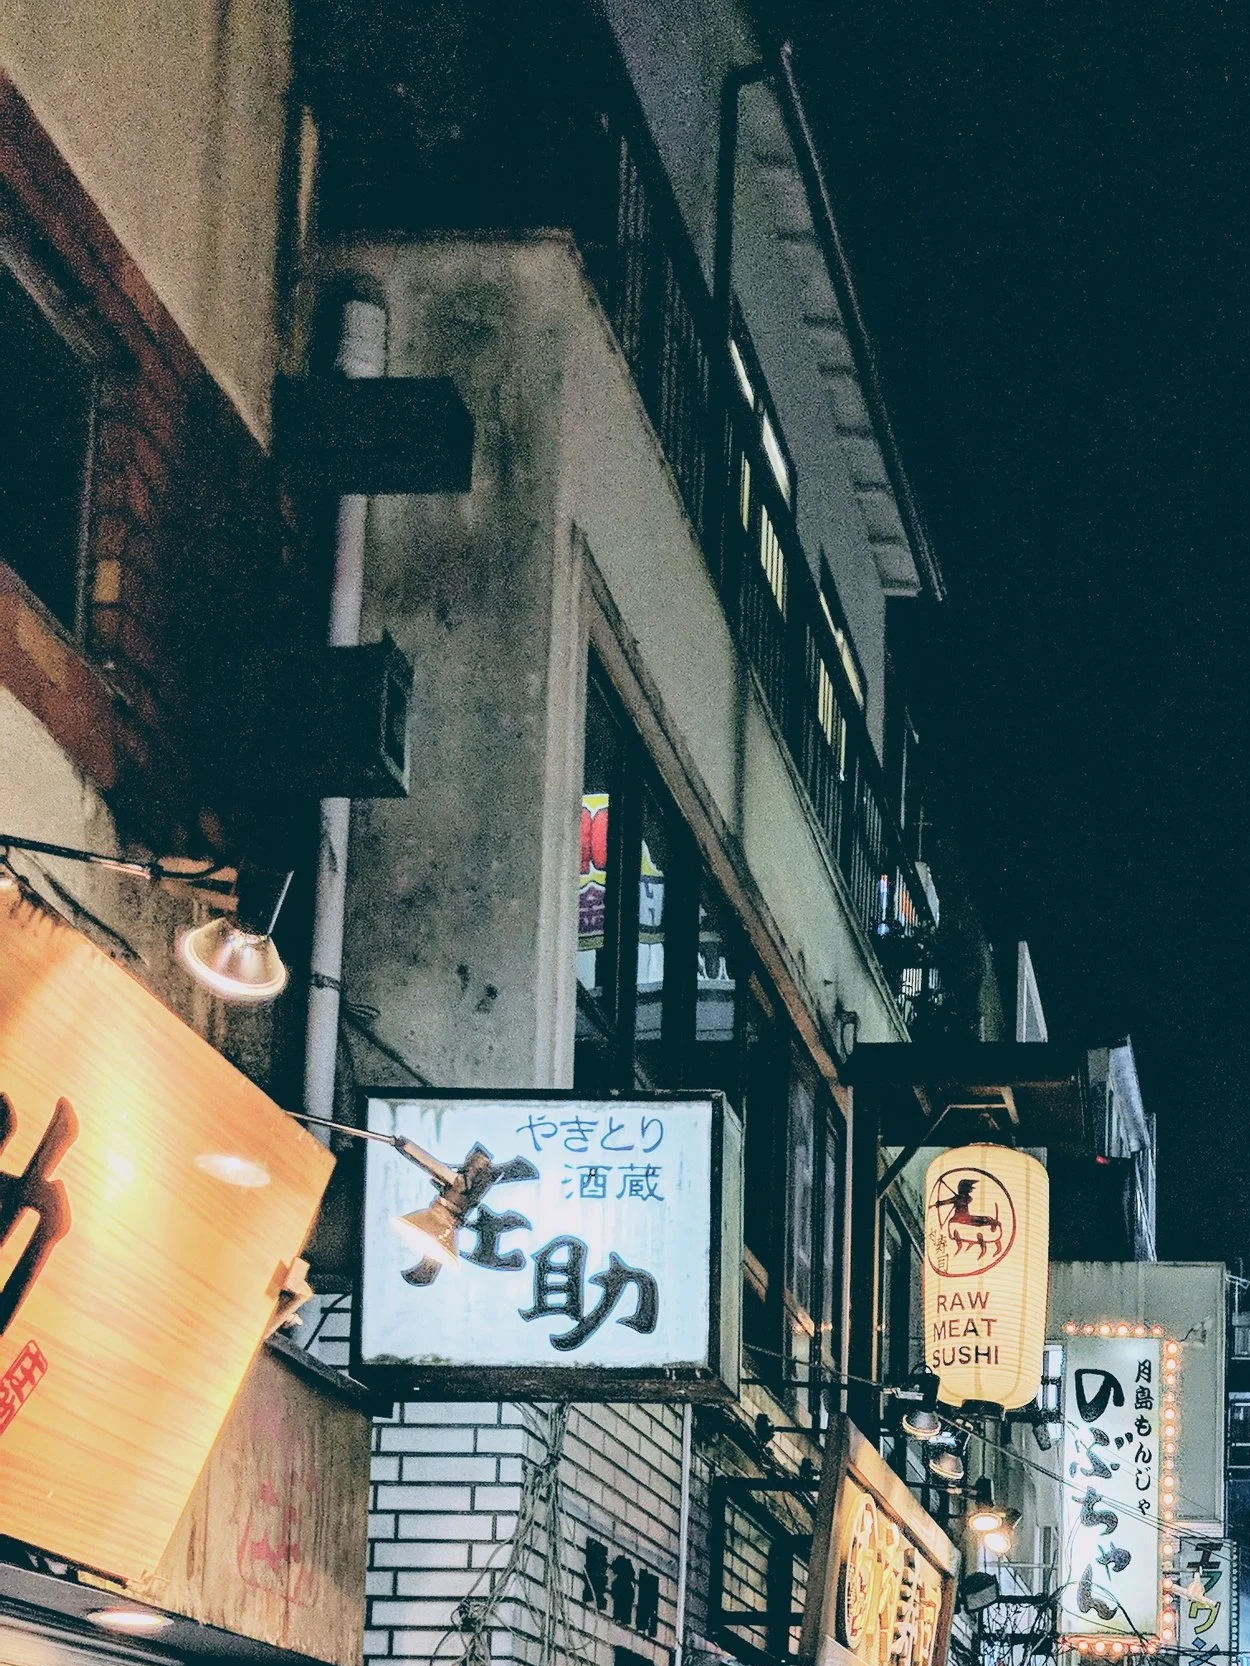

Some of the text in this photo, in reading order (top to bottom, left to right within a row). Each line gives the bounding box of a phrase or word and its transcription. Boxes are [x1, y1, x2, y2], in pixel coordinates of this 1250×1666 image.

[516, 1114, 665, 1154] やきとり
[561, 1163, 666, 1201] 酒蔵
[936, 1291, 990, 1314] RAW
[932, 1318, 997, 1342] MEAT
[932, 1345, 1000, 1369] SUSHI
[1135, 1359, 1153, 1516] 月島もんじゃ
[1069, 1368, 1132, 1621] のぶちゃん
